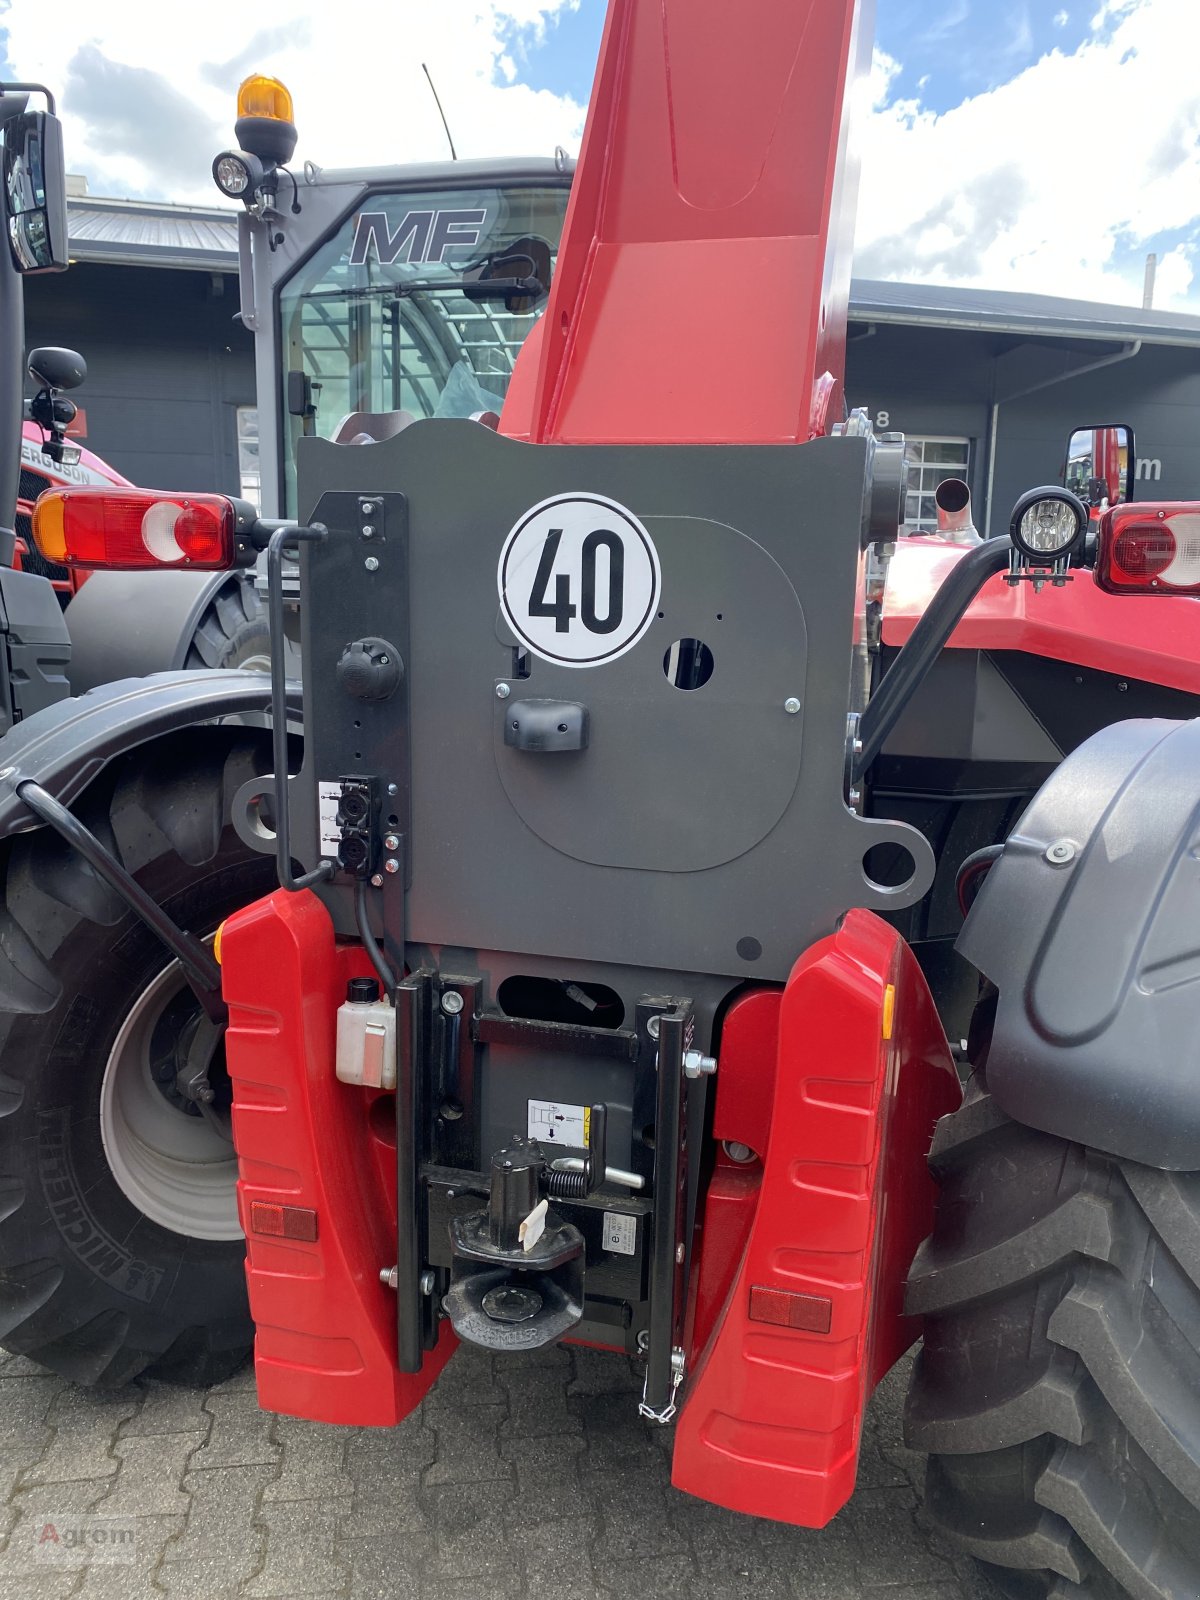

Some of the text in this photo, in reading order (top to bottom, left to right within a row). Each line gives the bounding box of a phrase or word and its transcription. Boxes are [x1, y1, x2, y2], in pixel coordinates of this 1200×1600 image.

[349, 209, 487, 265] MF
[876, 411, 890, 428] 8
[21, 445, 90, 486] ERGUSON
[528, 528, 625, 635] 40
